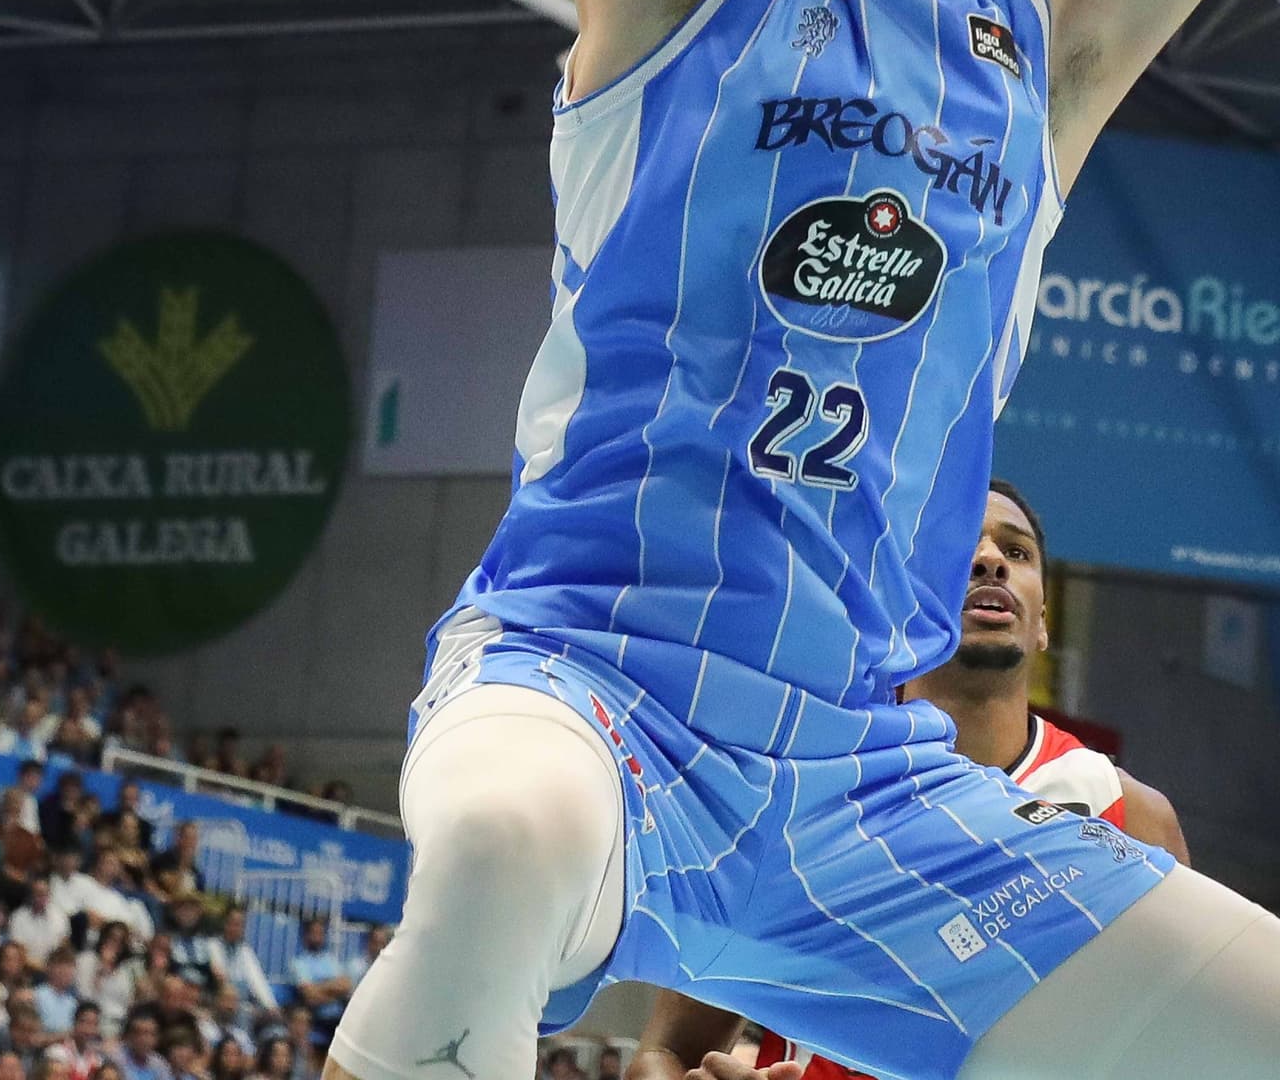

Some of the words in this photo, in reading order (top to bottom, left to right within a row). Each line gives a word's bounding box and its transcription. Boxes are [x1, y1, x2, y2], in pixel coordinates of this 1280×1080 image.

[975, 27, 1000, 47] liga
[754, 96, 1013, 227] BREOGÁN
[798, 219, 923, 278] Estrella
[793, 257, 897, 308] Galicia
[1037, 272, 1184, 333] arcía
[747, 366, 870, 492] 22
[0, 453, 152, 500] CAIXA
[164, 449, 328, 496] RURAL
[56, 518, 255, 565] GALEGA
[1028, 803, 1061, 824] acb
[972, 872, 1036, 923] XUNTA
[983, 912, 1012, 940] DE
[1010, 864, 1085, 919] GALICIA
